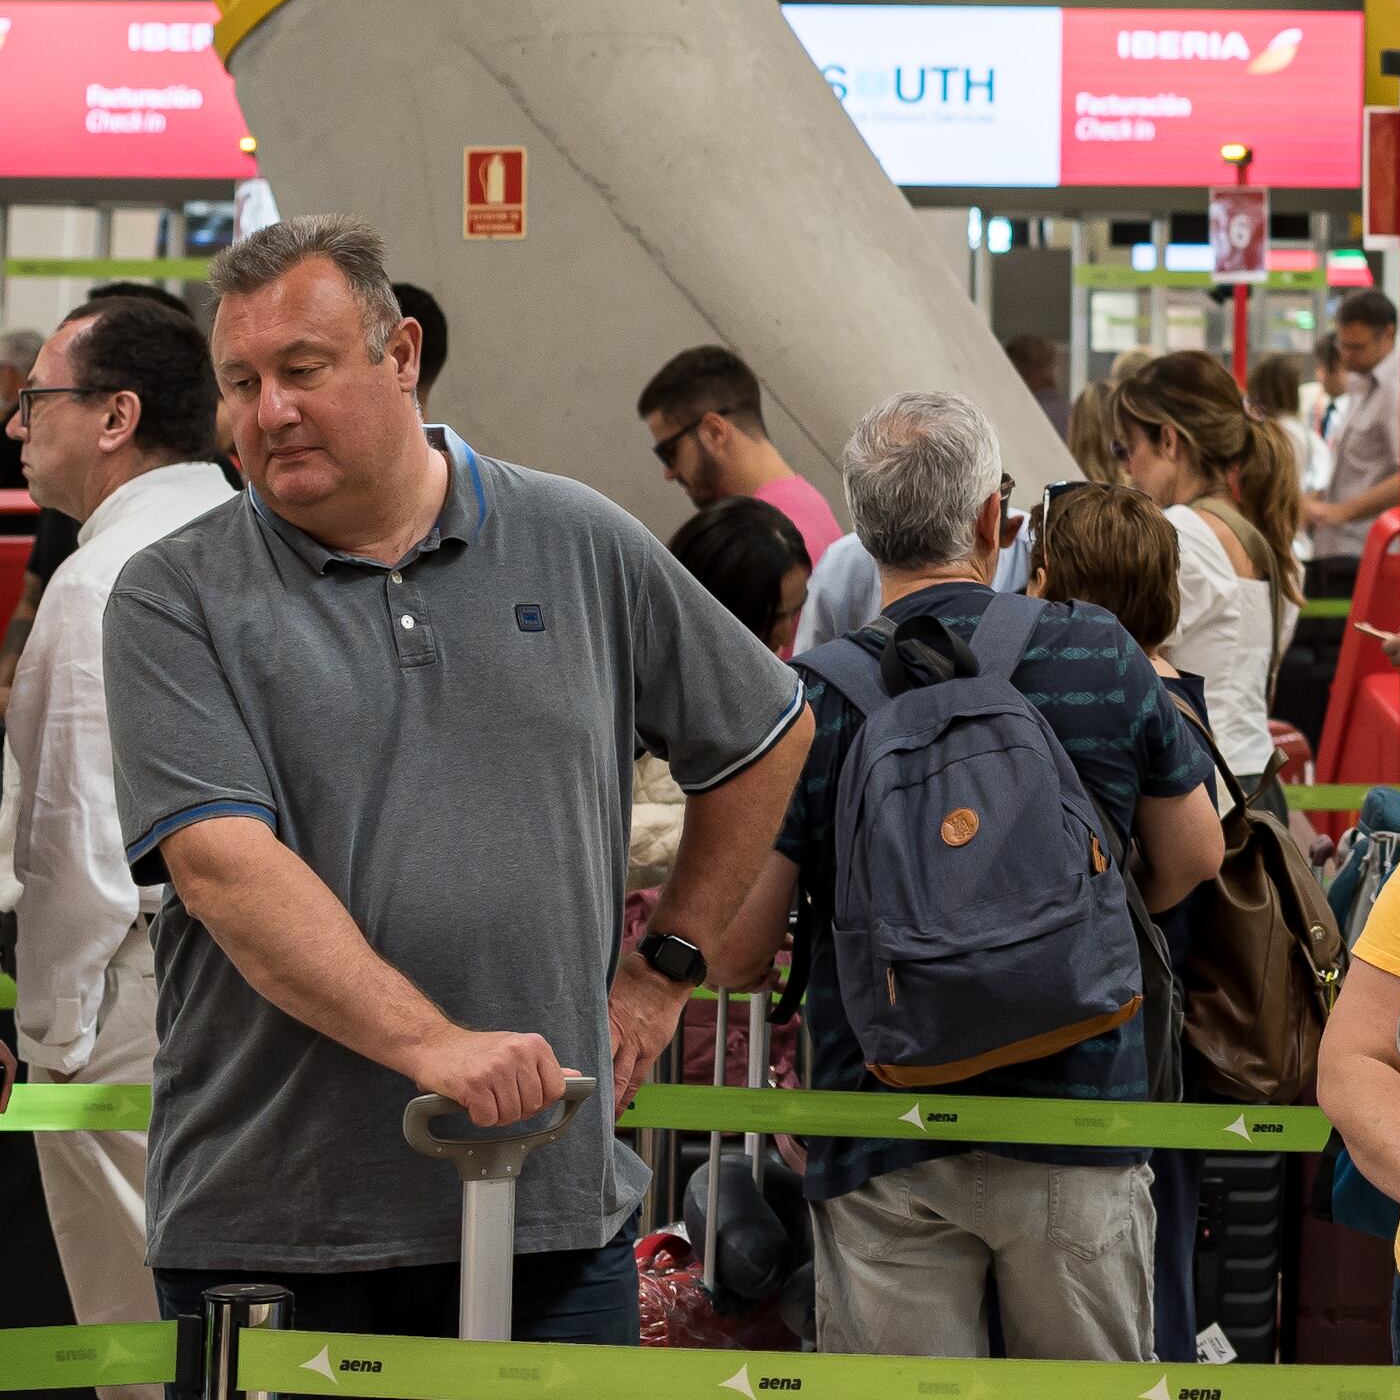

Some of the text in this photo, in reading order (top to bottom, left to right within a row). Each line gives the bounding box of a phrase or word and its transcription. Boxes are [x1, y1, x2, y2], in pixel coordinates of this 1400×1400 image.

[1117, 30, 1250, 60] IBERIA
[820, 64, 994, 104] SUTH
[1228, 213, 1253, 248] 6
[926, 1112, 958, 1123] aena
[1252, 1123, 1284, 1133] aena
[339, 1358, 383, 1373] aena
[758, 1375, 802, 1391] aena
[1178, 1387, 1222, 1400] aena
